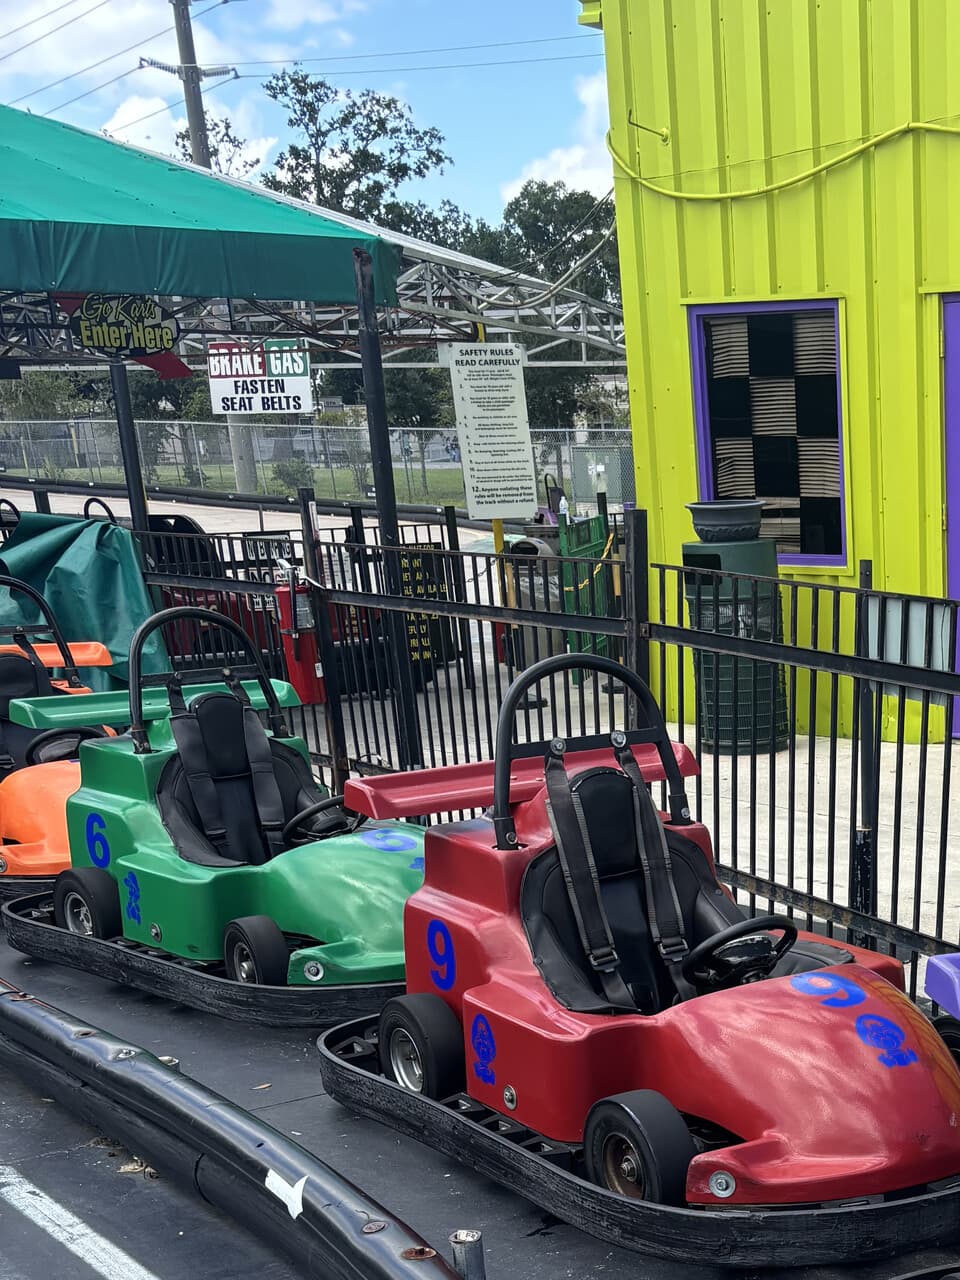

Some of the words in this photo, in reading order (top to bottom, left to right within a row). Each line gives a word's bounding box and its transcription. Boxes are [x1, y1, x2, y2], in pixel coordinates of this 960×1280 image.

[83, 293, 112, 322] Go
[115, 295, 157, 325] Karts
[80, 320, 127, 347] Enter
[131, 323, 174, 349] Here
[209, 347, 263, 376] BRAKE
[269, 346, 304, 375] GAS
[459, 349, 488, 357] SAFETY
[490, 348, 514, 356] RULES
[478, 359, 521, 367] CAREFULLY
[233, 379, 286, 395] FASTEN
[221, 397, 254, 412] SEAT
[261, 395, 302, 411] BELTS
[86, 812, 110, 869] 6
[362, 828, 418, 852] 6
[427, 919, 456, 991] 9
[790, 972, 867, 1008] 9
